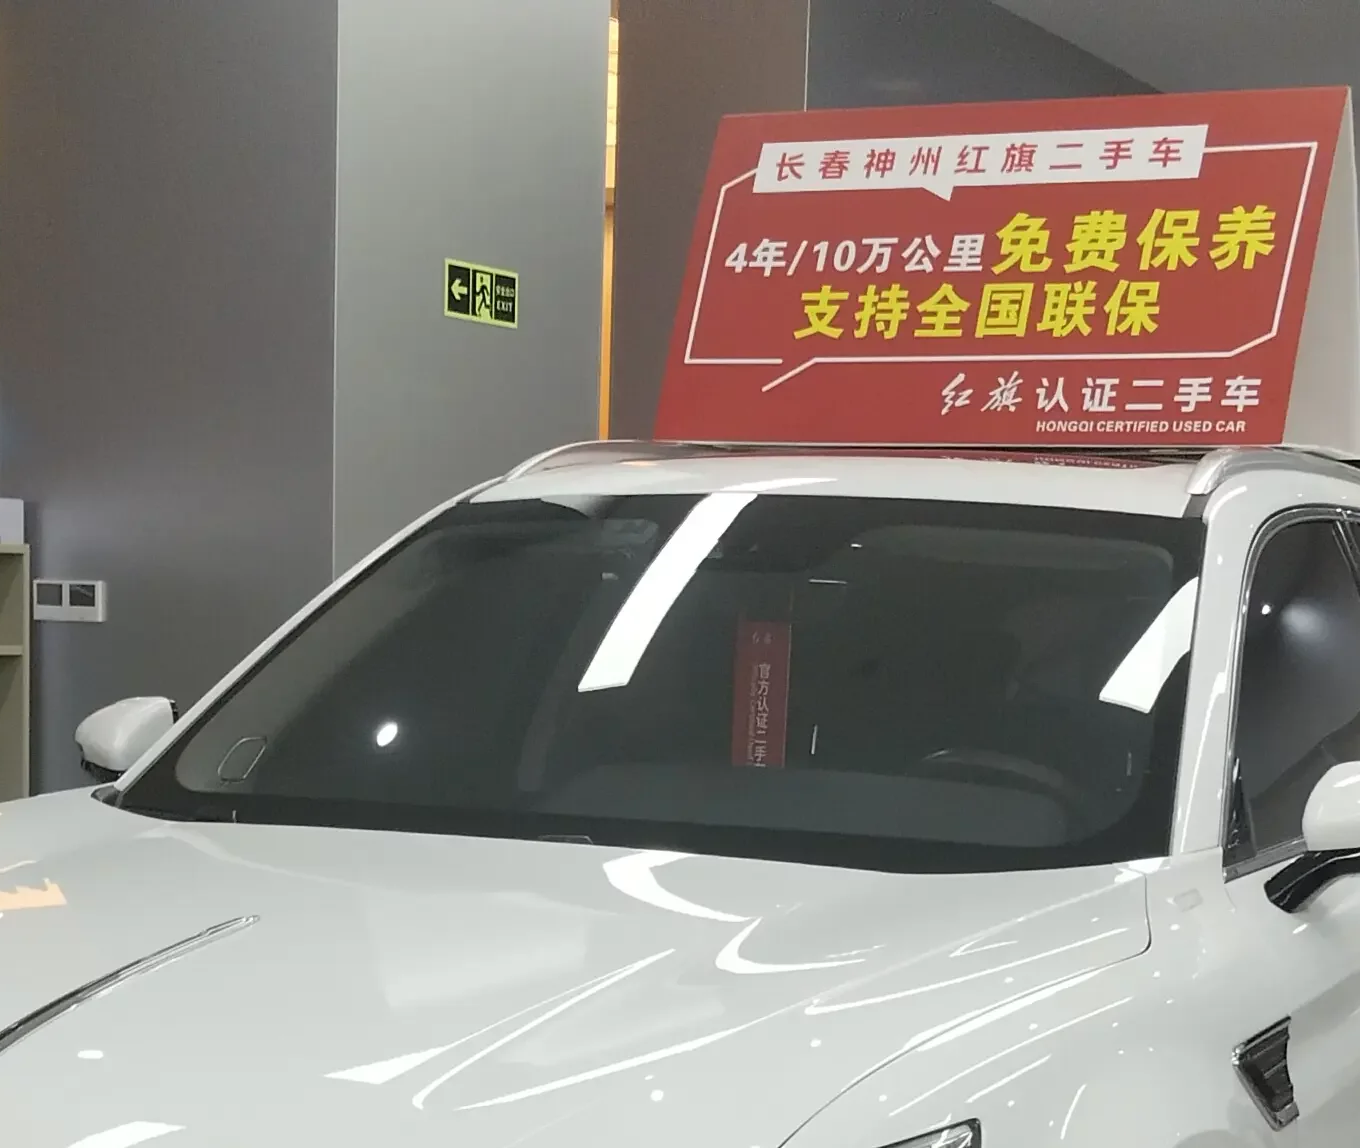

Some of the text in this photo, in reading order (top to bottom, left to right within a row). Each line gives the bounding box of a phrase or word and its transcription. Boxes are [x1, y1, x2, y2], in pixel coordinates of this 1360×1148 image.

[774, 135, 1186, 182] 长春神州红旗二手车
[496, 300, 513, 312] EXIT
[792, 279, 1162, 341] 支持全国联保
[1036, 419, 1248, 433] HONGQI CERTIFIED USED CAR
[754, 663, 771, 768] 官方认证二手
